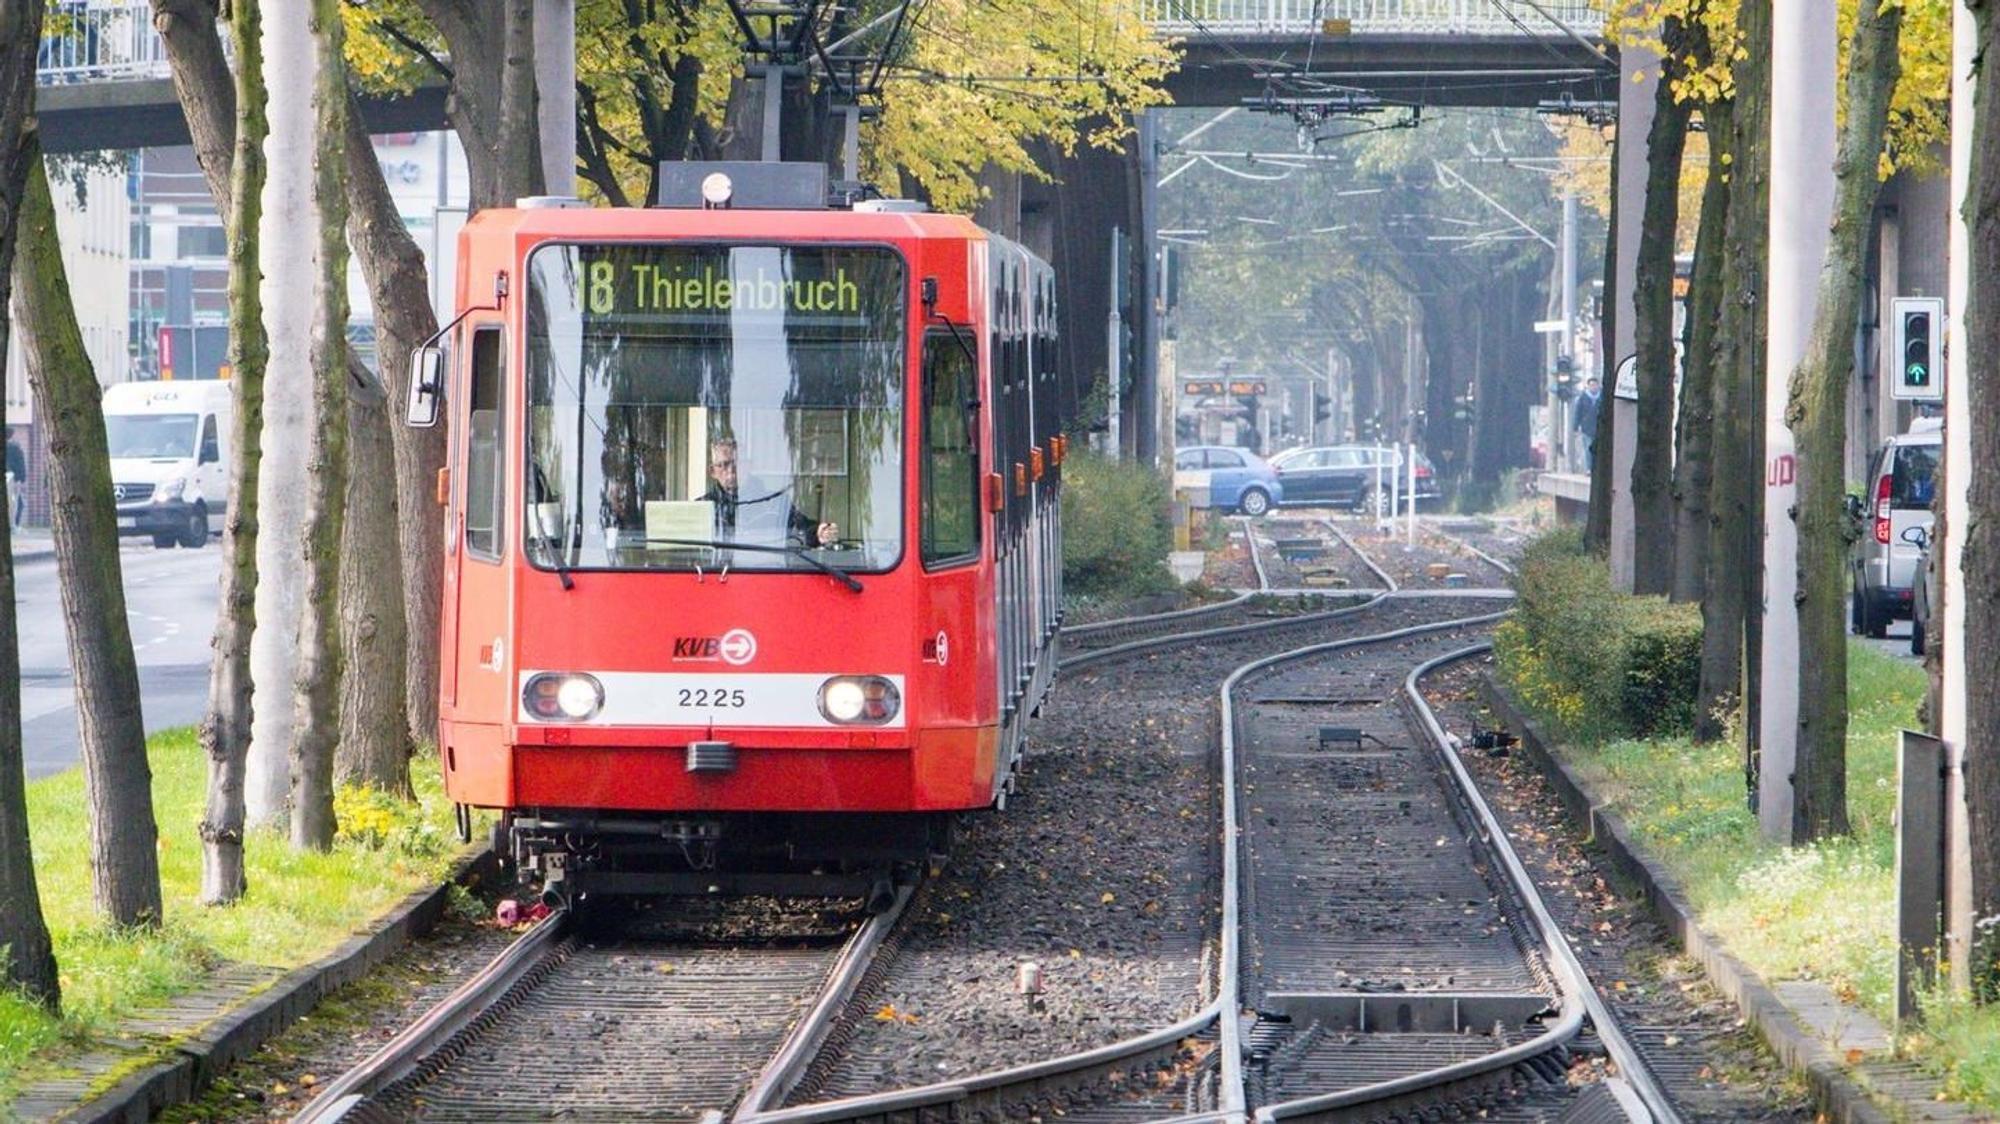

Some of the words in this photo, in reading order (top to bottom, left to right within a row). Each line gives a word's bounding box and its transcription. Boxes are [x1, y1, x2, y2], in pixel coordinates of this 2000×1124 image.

[578, 260, 615, 314] 18
[631, 264, 858, 312] Thielenbruch
[672, 637, 720, 657] KVB
[678, 688, 746, 708] 2225
